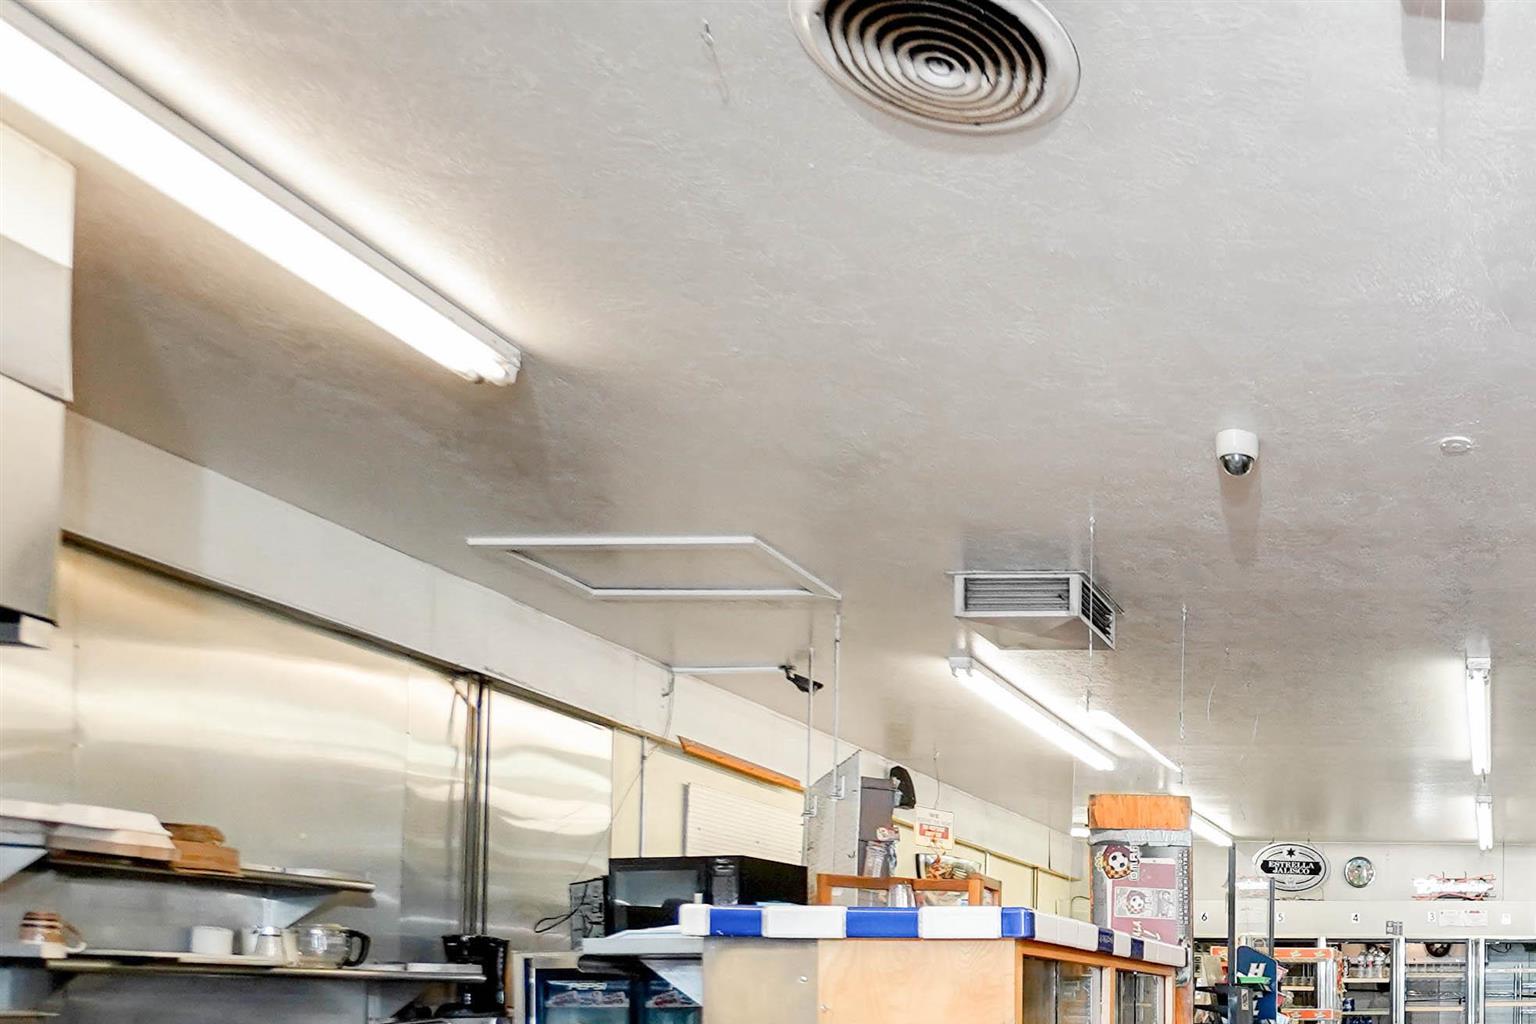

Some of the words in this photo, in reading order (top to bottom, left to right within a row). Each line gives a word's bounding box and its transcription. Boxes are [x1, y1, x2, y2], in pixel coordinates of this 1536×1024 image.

[1268, 860, 1315, 870] ESTRELLA
[1272, 867, 1311, 875] JALISCO
[1201, 912, 1208, 921] 6
[1277, 912, 1284, 921] 5
[1352, 913, 1359, 922] 4
[1429, 912, 1435, 922] 3
